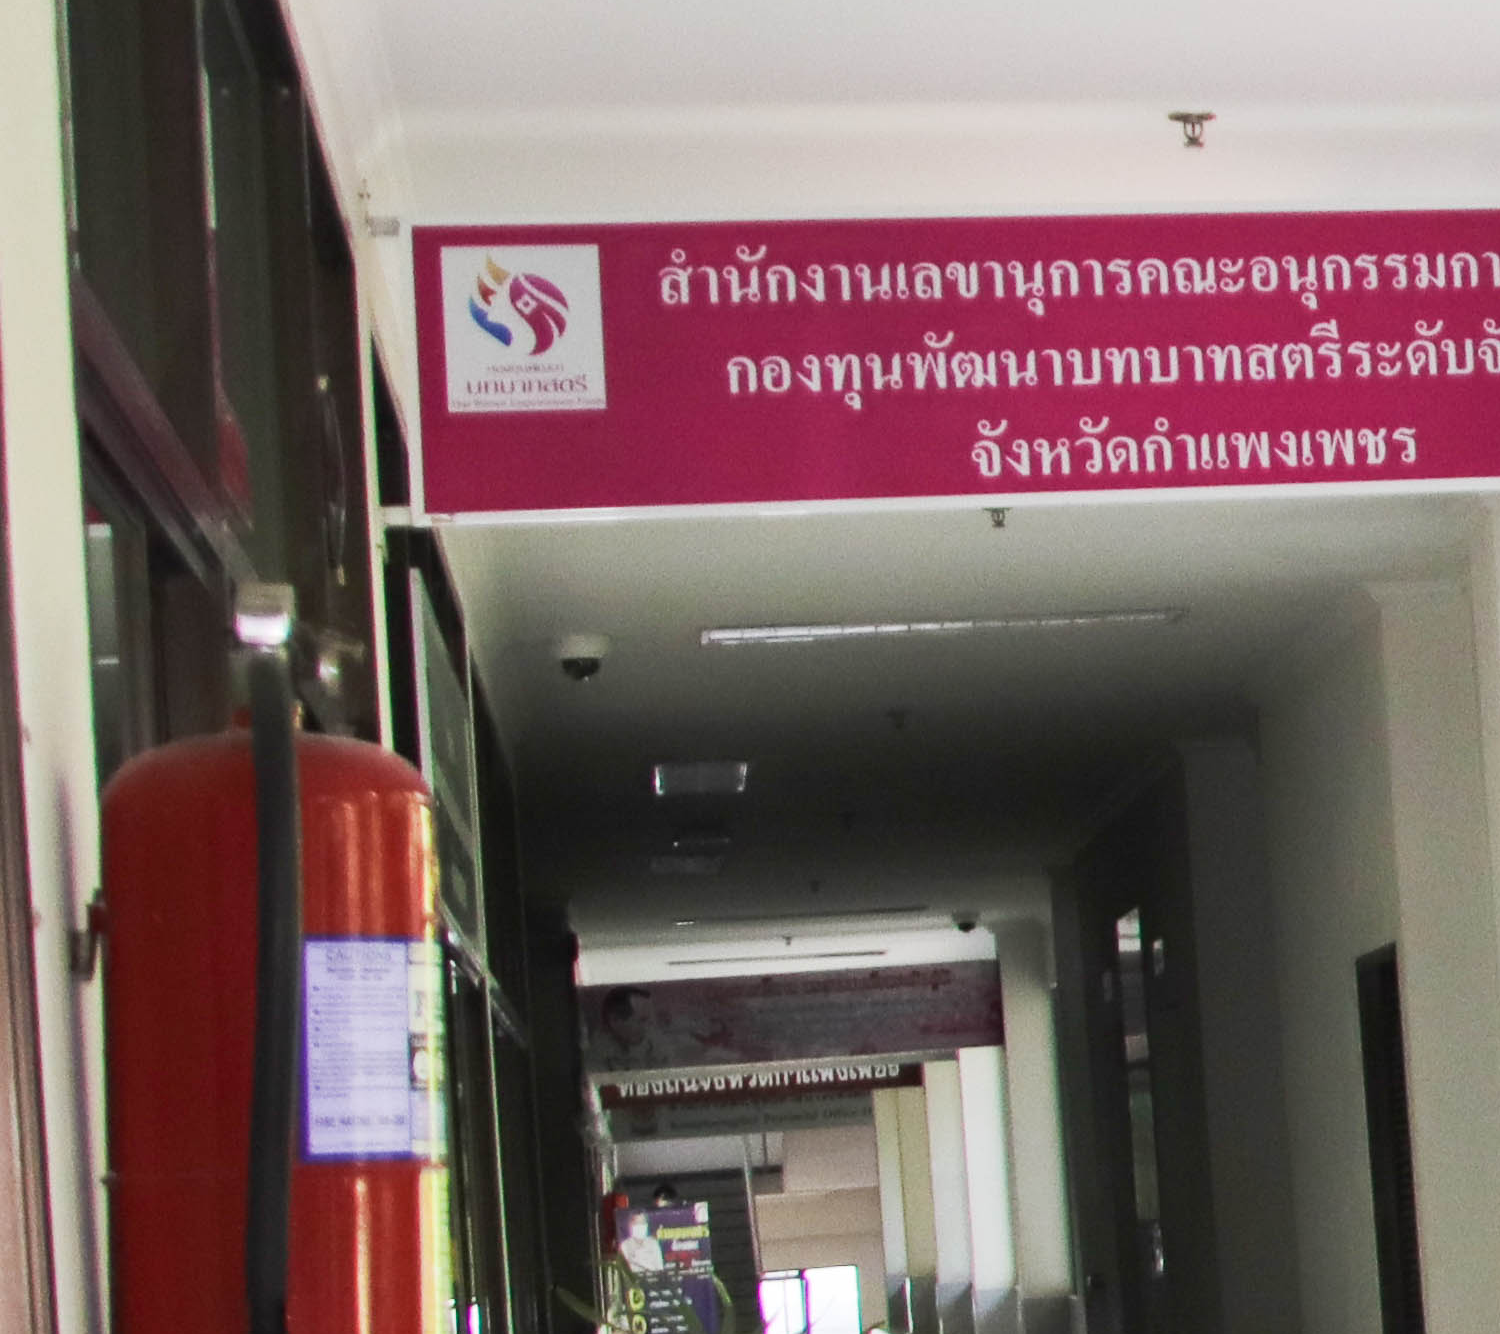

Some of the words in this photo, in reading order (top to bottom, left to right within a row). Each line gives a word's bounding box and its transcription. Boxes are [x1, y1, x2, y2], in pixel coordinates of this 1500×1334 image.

[970, 416, 1418, 478] จังหวัดกำแพงเพชร
